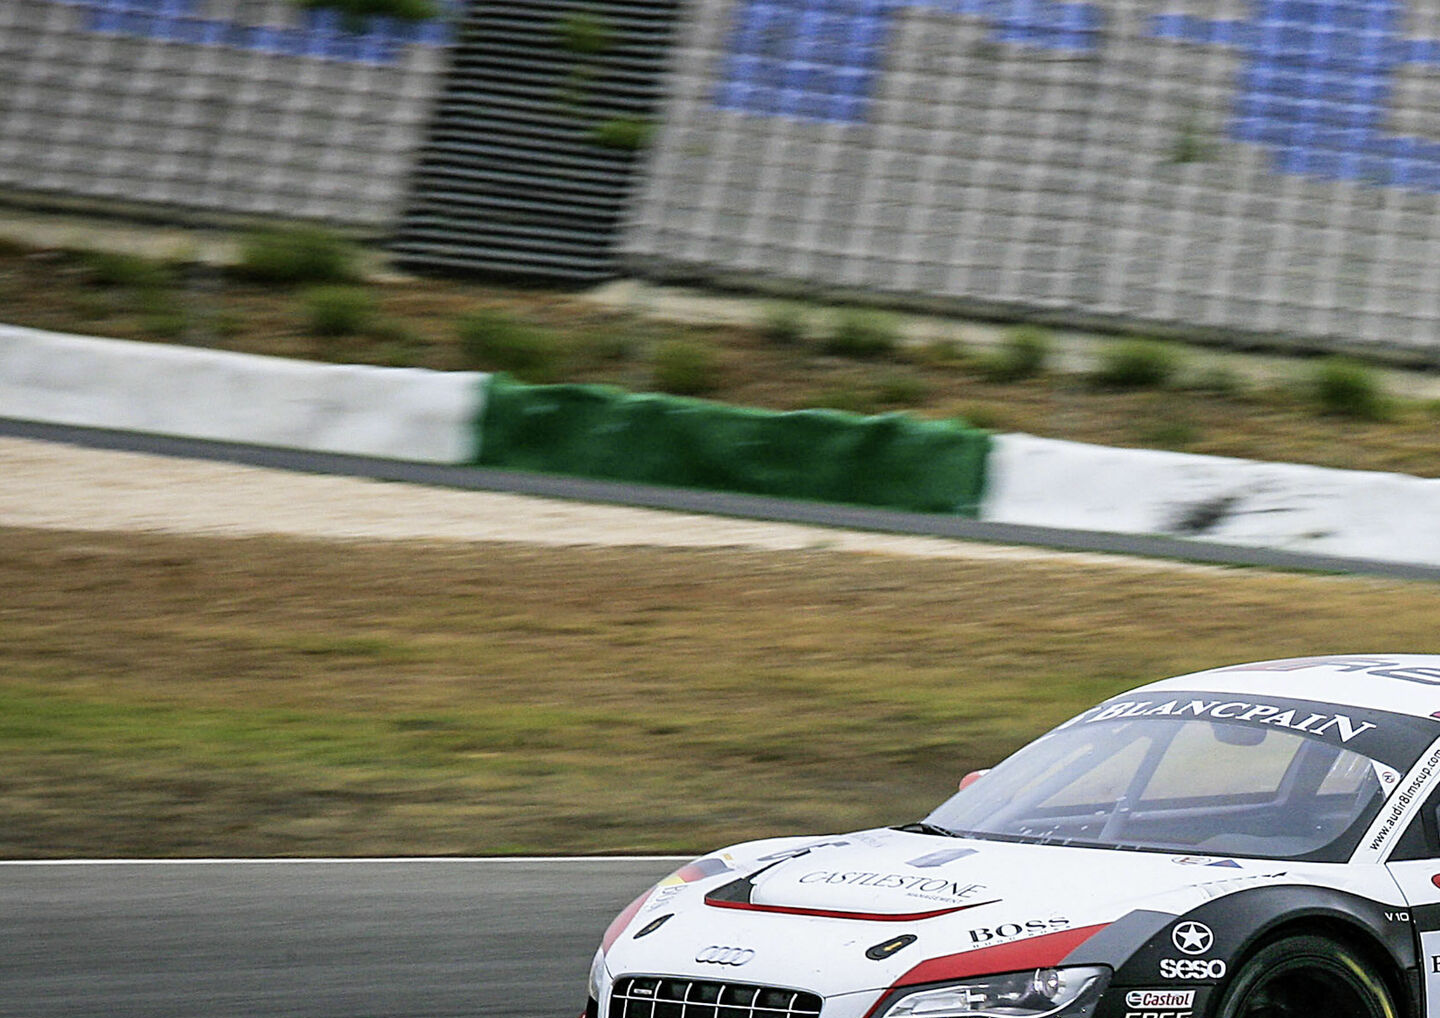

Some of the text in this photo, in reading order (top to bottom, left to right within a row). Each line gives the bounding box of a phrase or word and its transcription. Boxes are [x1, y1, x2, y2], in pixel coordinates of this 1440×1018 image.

[1086, 699, 1377, 743] BLANCPAIN
[799, 871, 987, 899] CASTLESTONE
[969, 917, 1070, 943] BOSS
[1142, 993, 1190, 1006] Castrol
